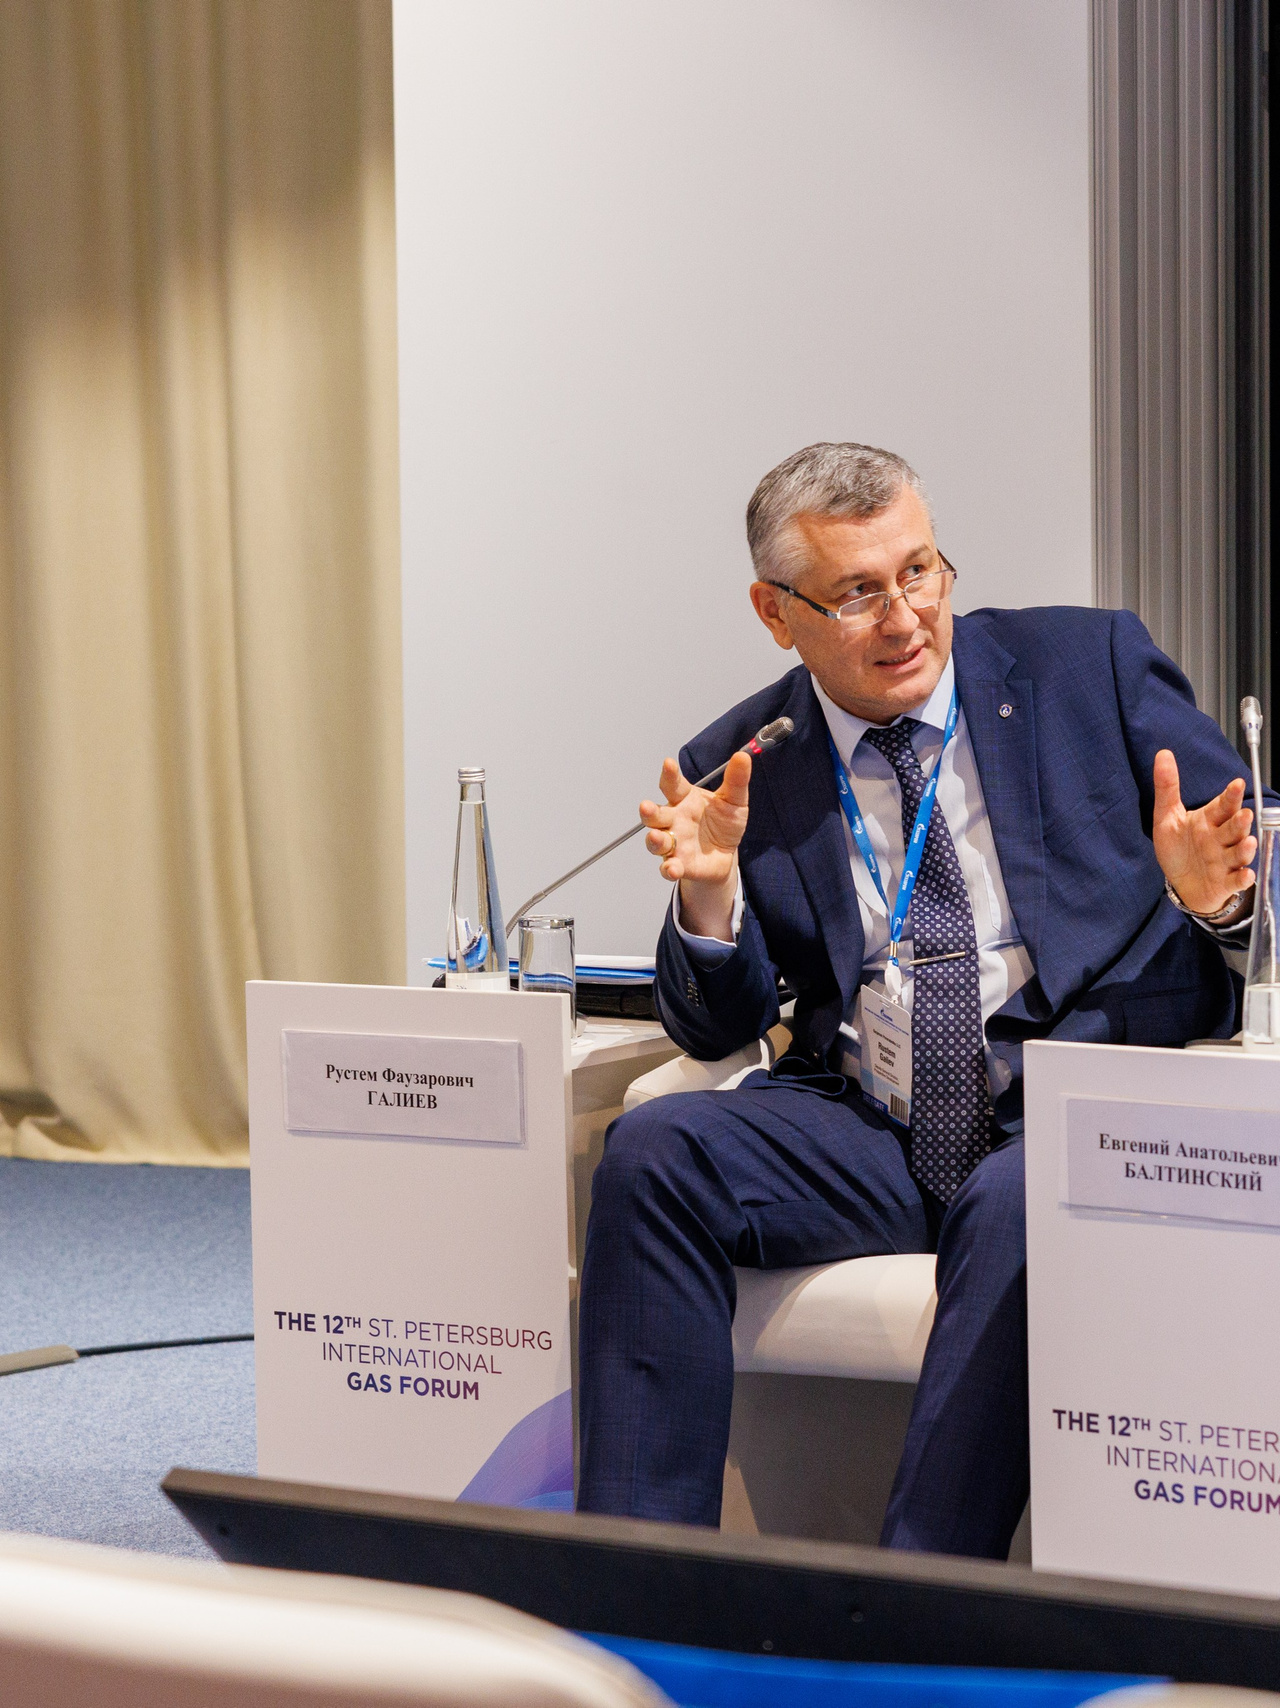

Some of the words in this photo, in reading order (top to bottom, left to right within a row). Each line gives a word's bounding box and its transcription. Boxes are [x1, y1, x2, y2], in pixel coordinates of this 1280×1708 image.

[325, 1064, 378, 1083] Рустем
[382, 1068, 474, 1088] Фаузарович
[367, 1090, 438, 1109] ГАЛИЕВ
[1098, 1133, 1170, 1157] Евгений
[1124, 1162, 1262, 1192] БАЛТИНСКИЙ
[274, 1310, 317, 1332] THE
[368, 1318, 397, 1339] ST.
[405, 1321, 552, 1351] PETERSBURG
[323, 1342, 502, 1375] INTERNATIONAL
[347, 1372, 392, 1393] GAS
[399, 1376, 480, 1400] FORUM
[1053, 1409, 1100, 1434] THE
[1159, 1420, 1191, 1444] ST.
[1134, 1479, 1185, 1504] GAS
